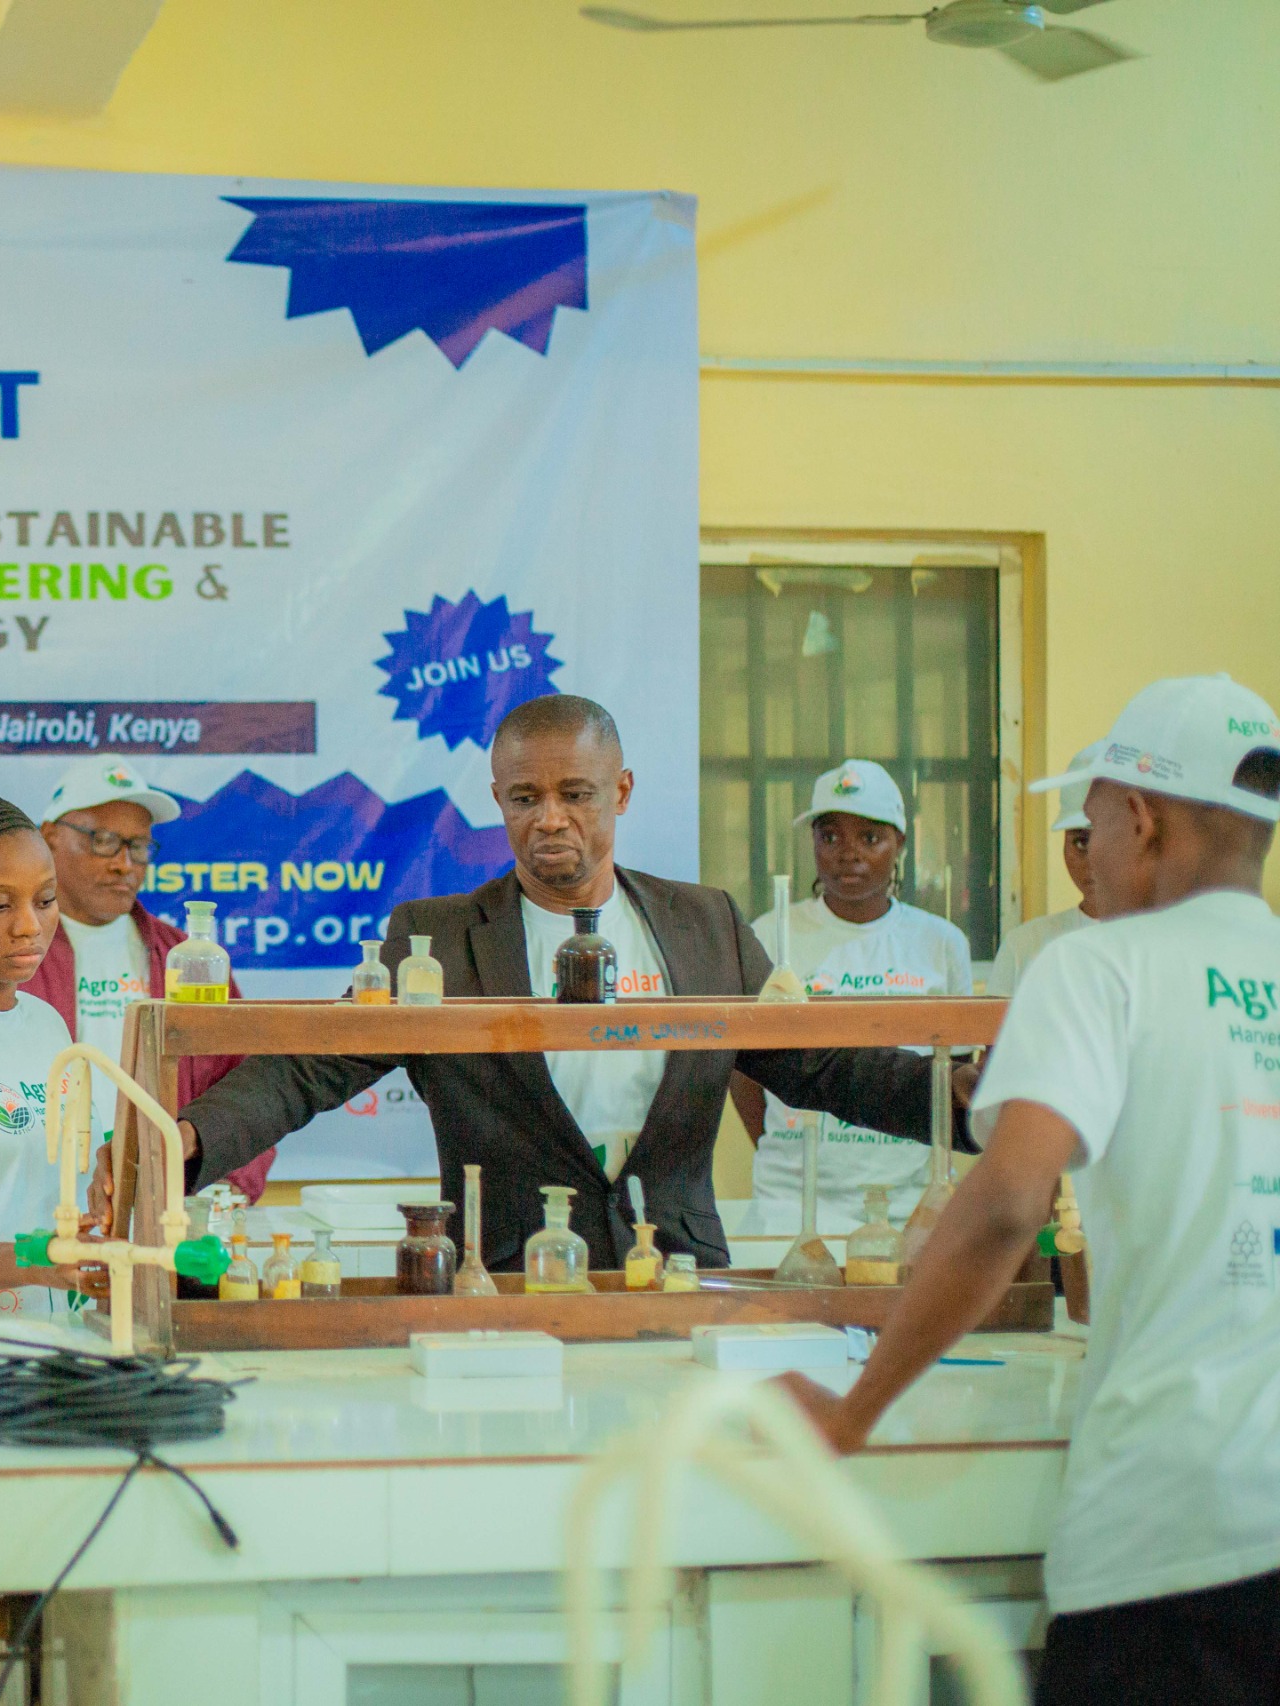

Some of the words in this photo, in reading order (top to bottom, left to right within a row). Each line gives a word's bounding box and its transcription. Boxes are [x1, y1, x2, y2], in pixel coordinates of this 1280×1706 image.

[195, 564, 229, 601] &
[405, 653, 482, 692] JOIN
[486, 643, 533, 674] US
[107, 712, 201, 750] Kenya
[138, 861, 269, 893] ISTER
[280, 860, 385, 892] NOW
[615, 969, 662, 994] olar
[839, 967, 925, 989] AgroSolar
[827, 1131, 876, 1145] SUSTAIN
